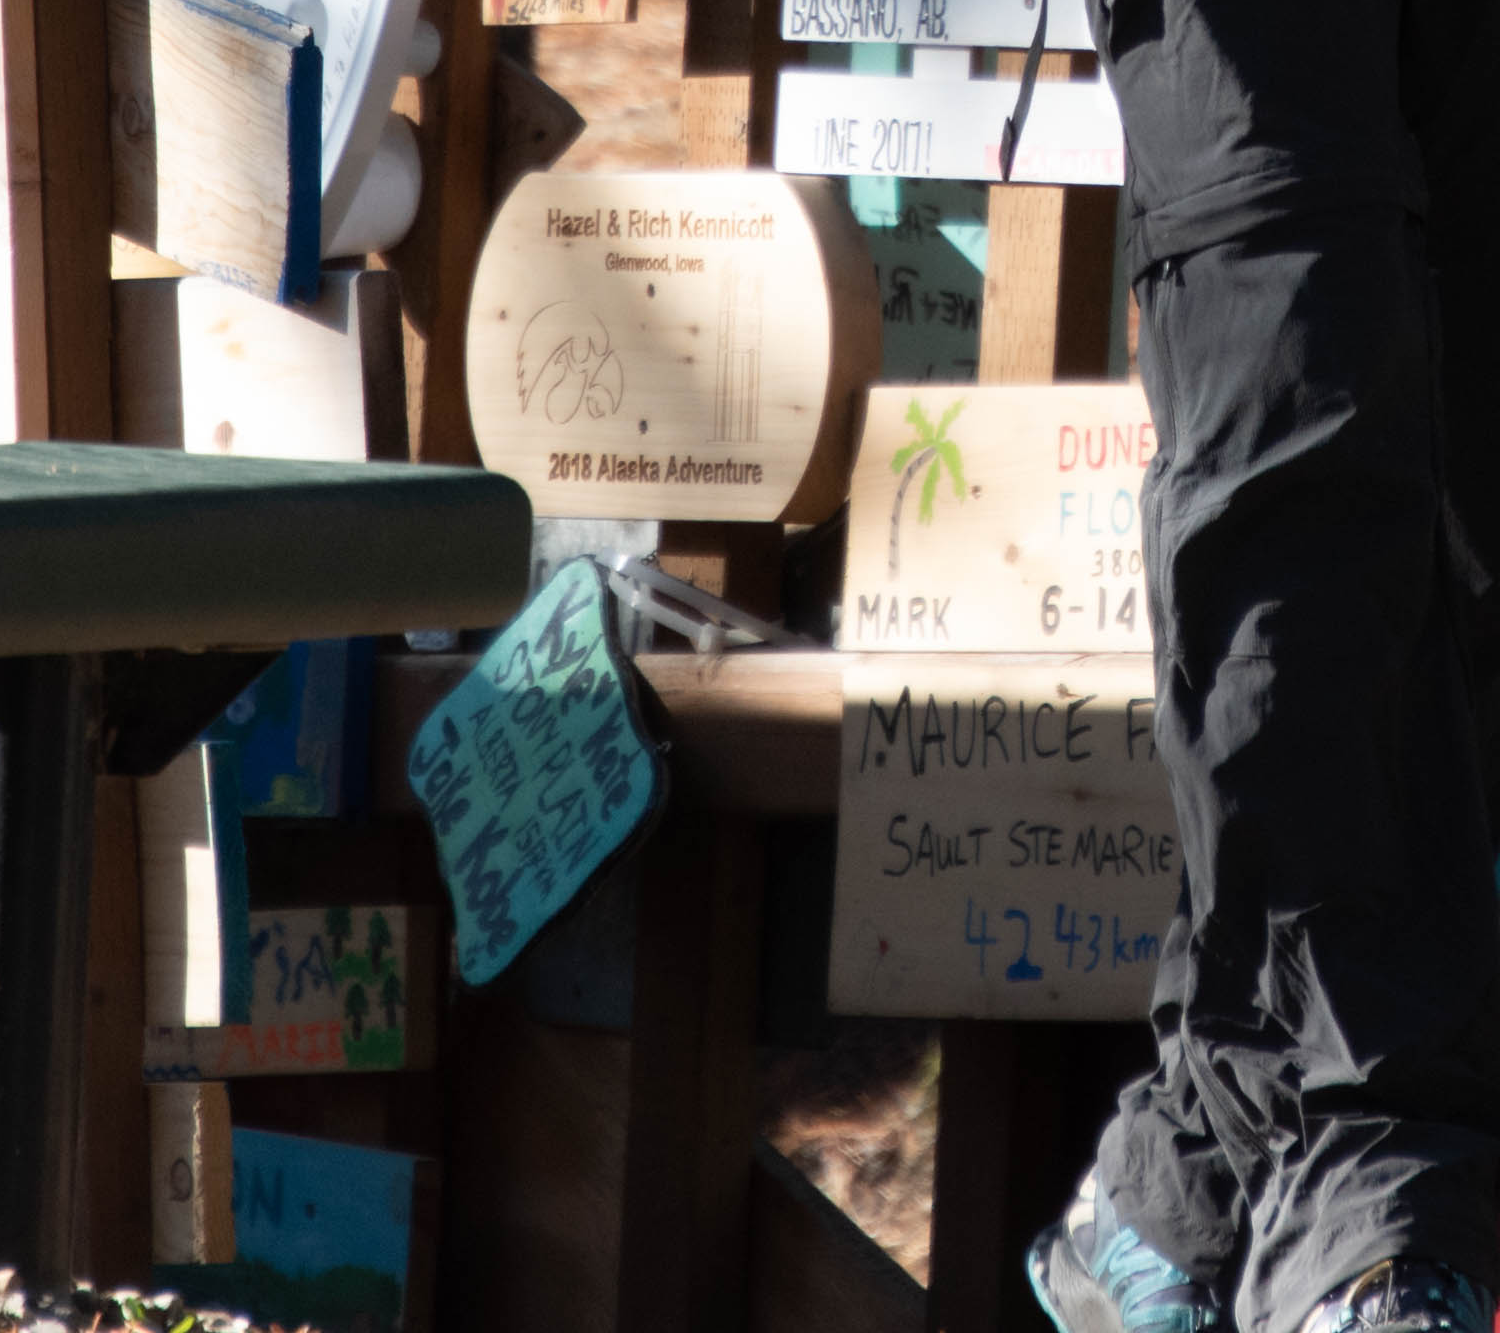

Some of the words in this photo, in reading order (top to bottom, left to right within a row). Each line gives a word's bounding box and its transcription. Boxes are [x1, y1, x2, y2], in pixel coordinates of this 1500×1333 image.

[545, 207, 601, 239] Hazel
[605, 208, 622, 238] &
[627, 208, 672, 238] Rich
[678, 209, 776, 240] Kennicott
[604, 251, 672, 276] Glenwood,
[675, 253, 706, 273] Iowa
[547, 453, 595, 484] 2018
[598, 454, 662, 485] Alaska
[665, 456, 764, 487] Adventure
[856, 594, 954, 642] MARK
[859, 684, 1095, 778] MAURICE
[882, 814, 995, 879] SAULT
[1075, 820, 1176, 874] MARIE
